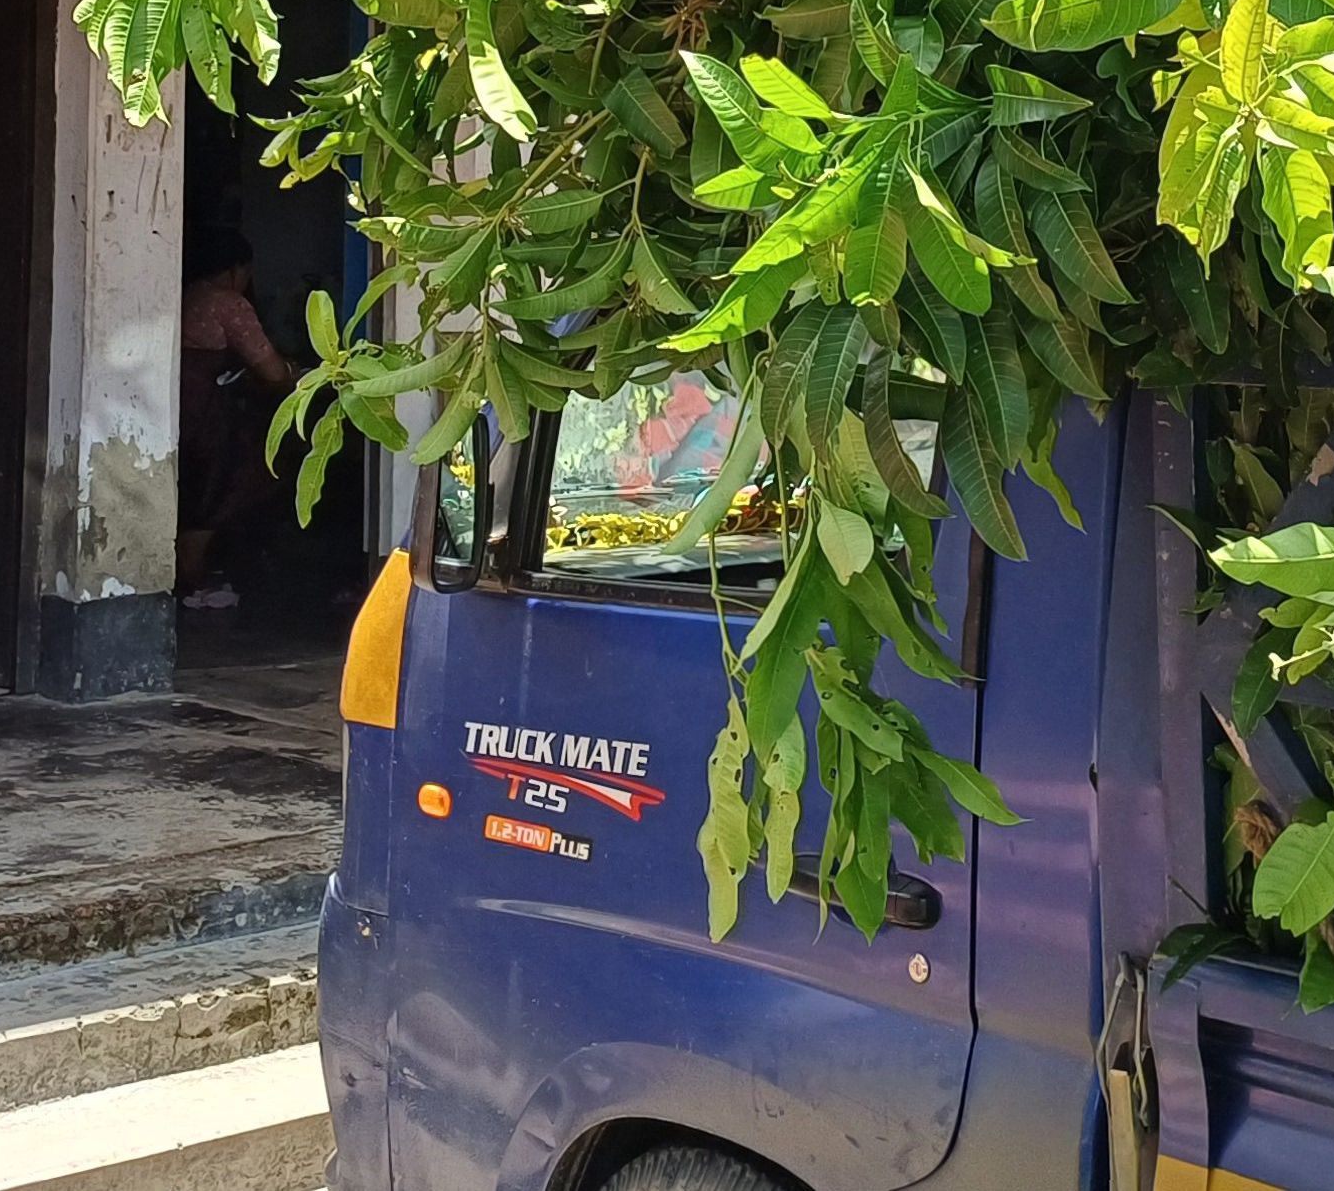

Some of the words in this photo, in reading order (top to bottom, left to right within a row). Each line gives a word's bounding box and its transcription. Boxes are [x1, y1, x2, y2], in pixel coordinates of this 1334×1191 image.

[465, 721, 556, 764] TRUCK
[560, 734, 650, 776] MATE
[506, 773, 570, 813] T25
[490, 820, 546, 847] 1.2-TON
